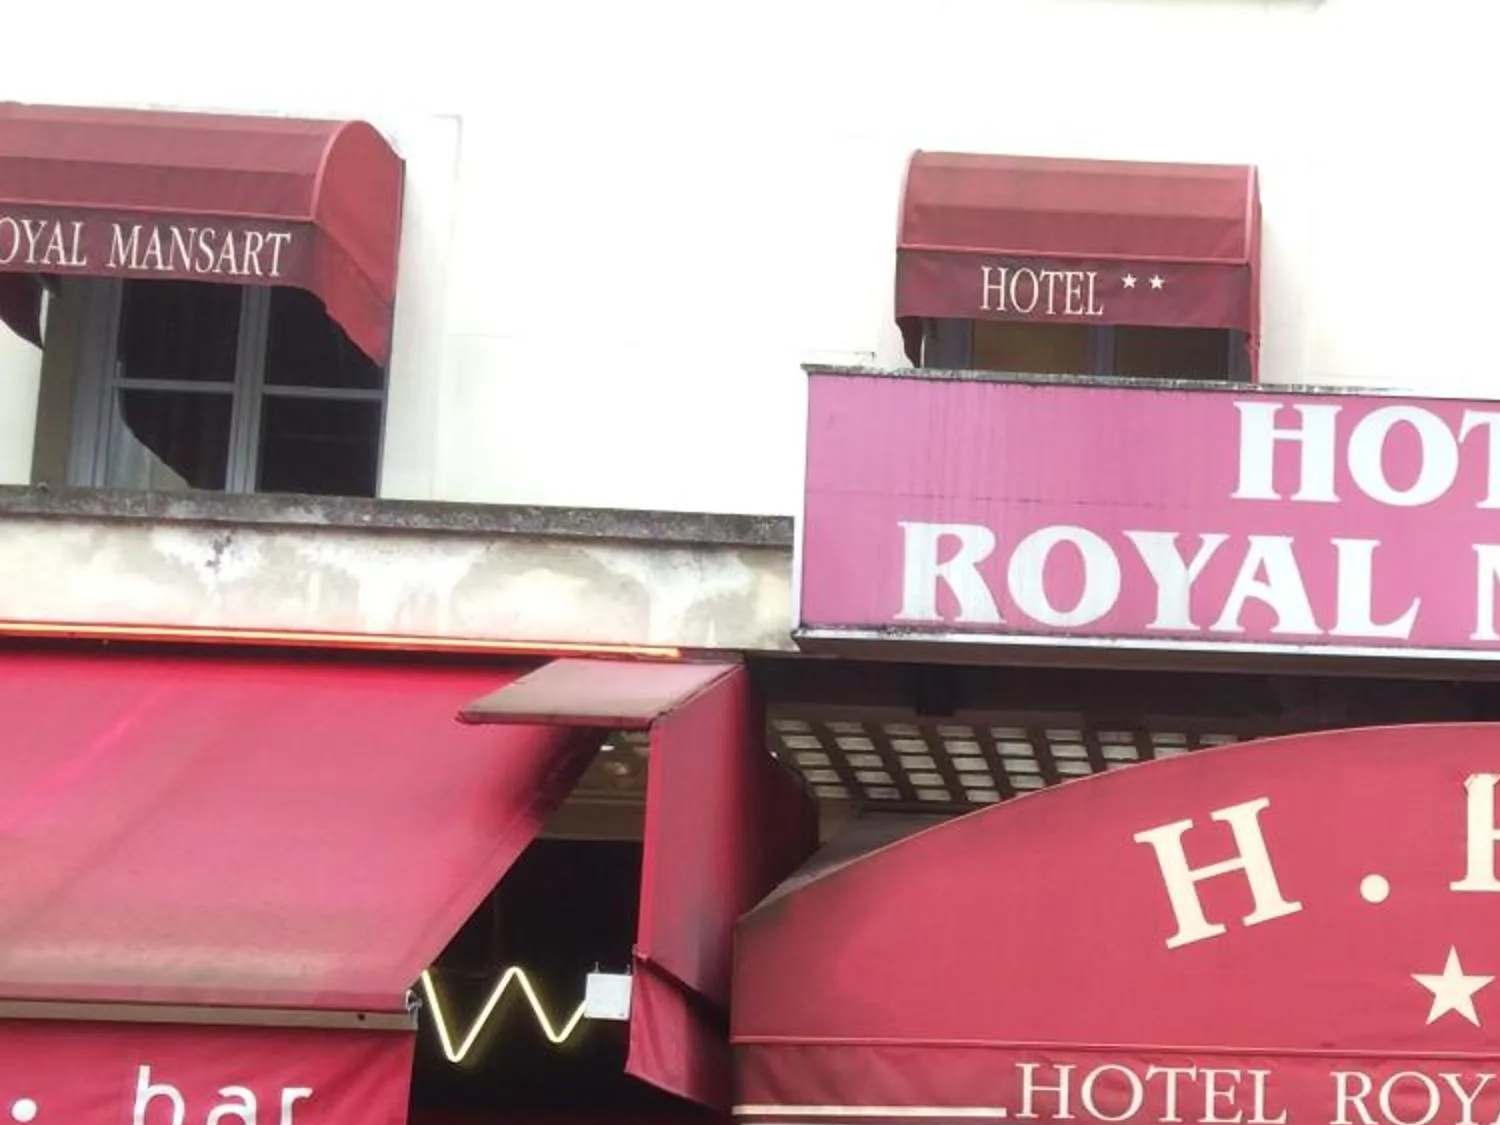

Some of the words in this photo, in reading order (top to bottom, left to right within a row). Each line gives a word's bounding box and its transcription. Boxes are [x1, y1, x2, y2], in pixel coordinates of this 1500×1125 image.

[105, 223, 291, 277] MANSART
[980, 266, 1103, 316] HOTEL
[893, 520, 1421, 641] ROYAL
[1015, 1062, 1288, 1125] HOTEL
